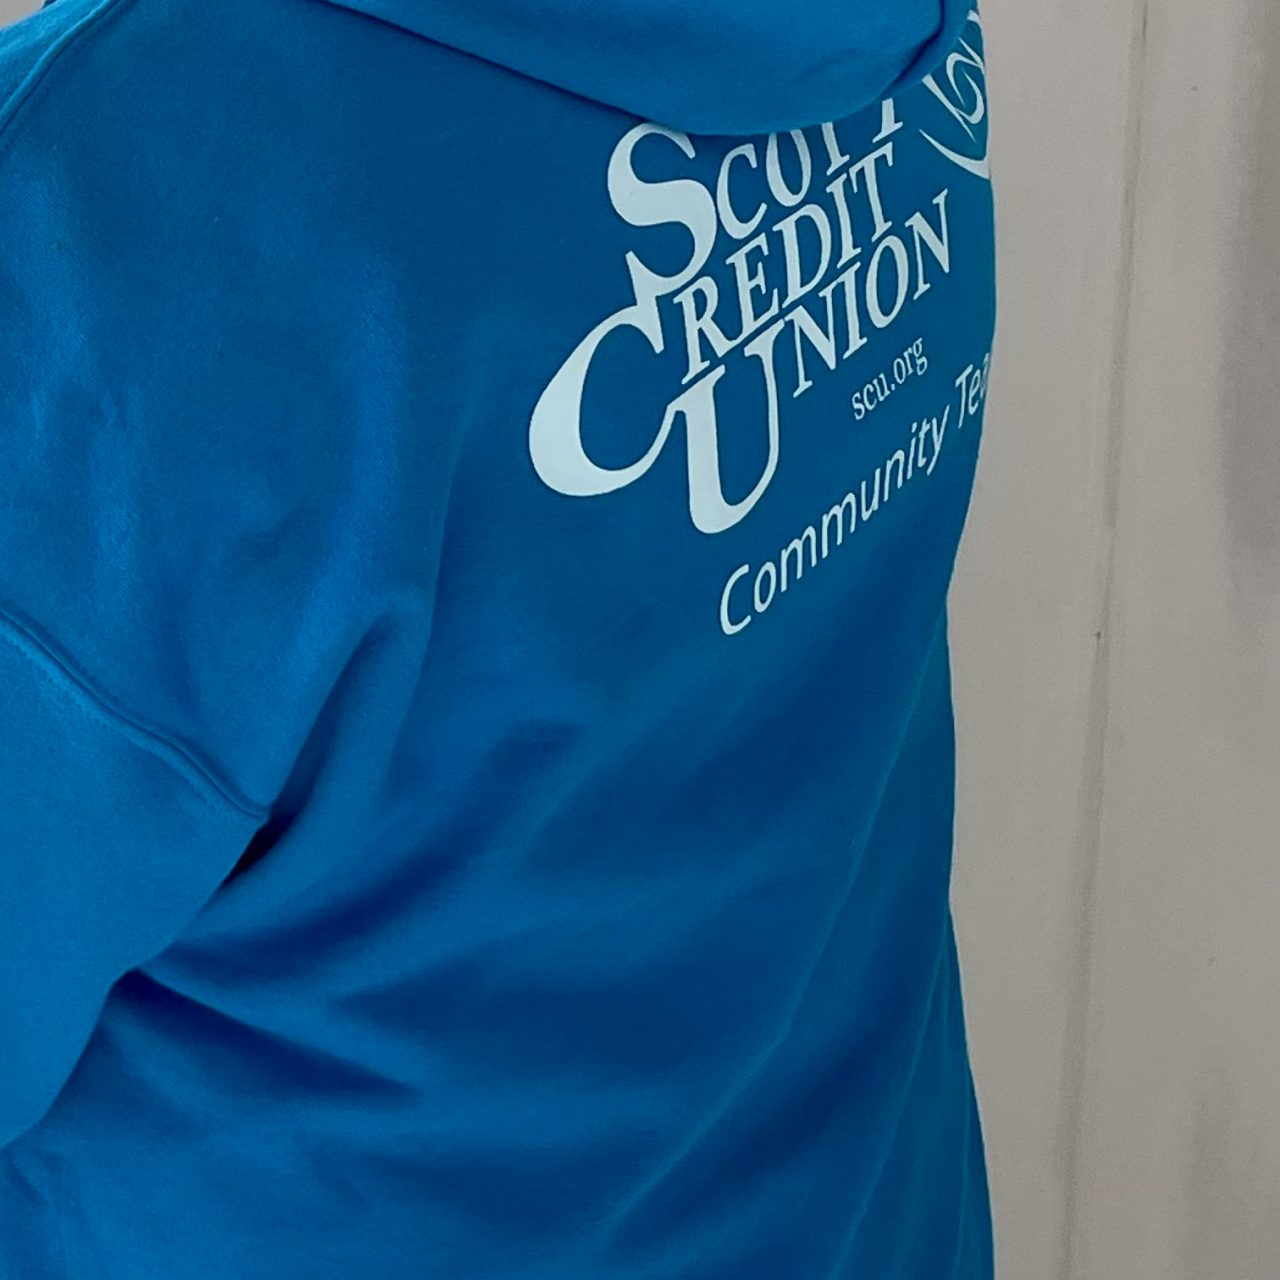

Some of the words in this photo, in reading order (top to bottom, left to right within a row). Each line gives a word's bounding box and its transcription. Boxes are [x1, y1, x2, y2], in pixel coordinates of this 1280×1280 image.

[528, 141, 893, 497] CREDIT
[669, 188, 950, 534] UNION
[852, 337, 928, 420] scu.org
[720, 404, 950, 635] Community
